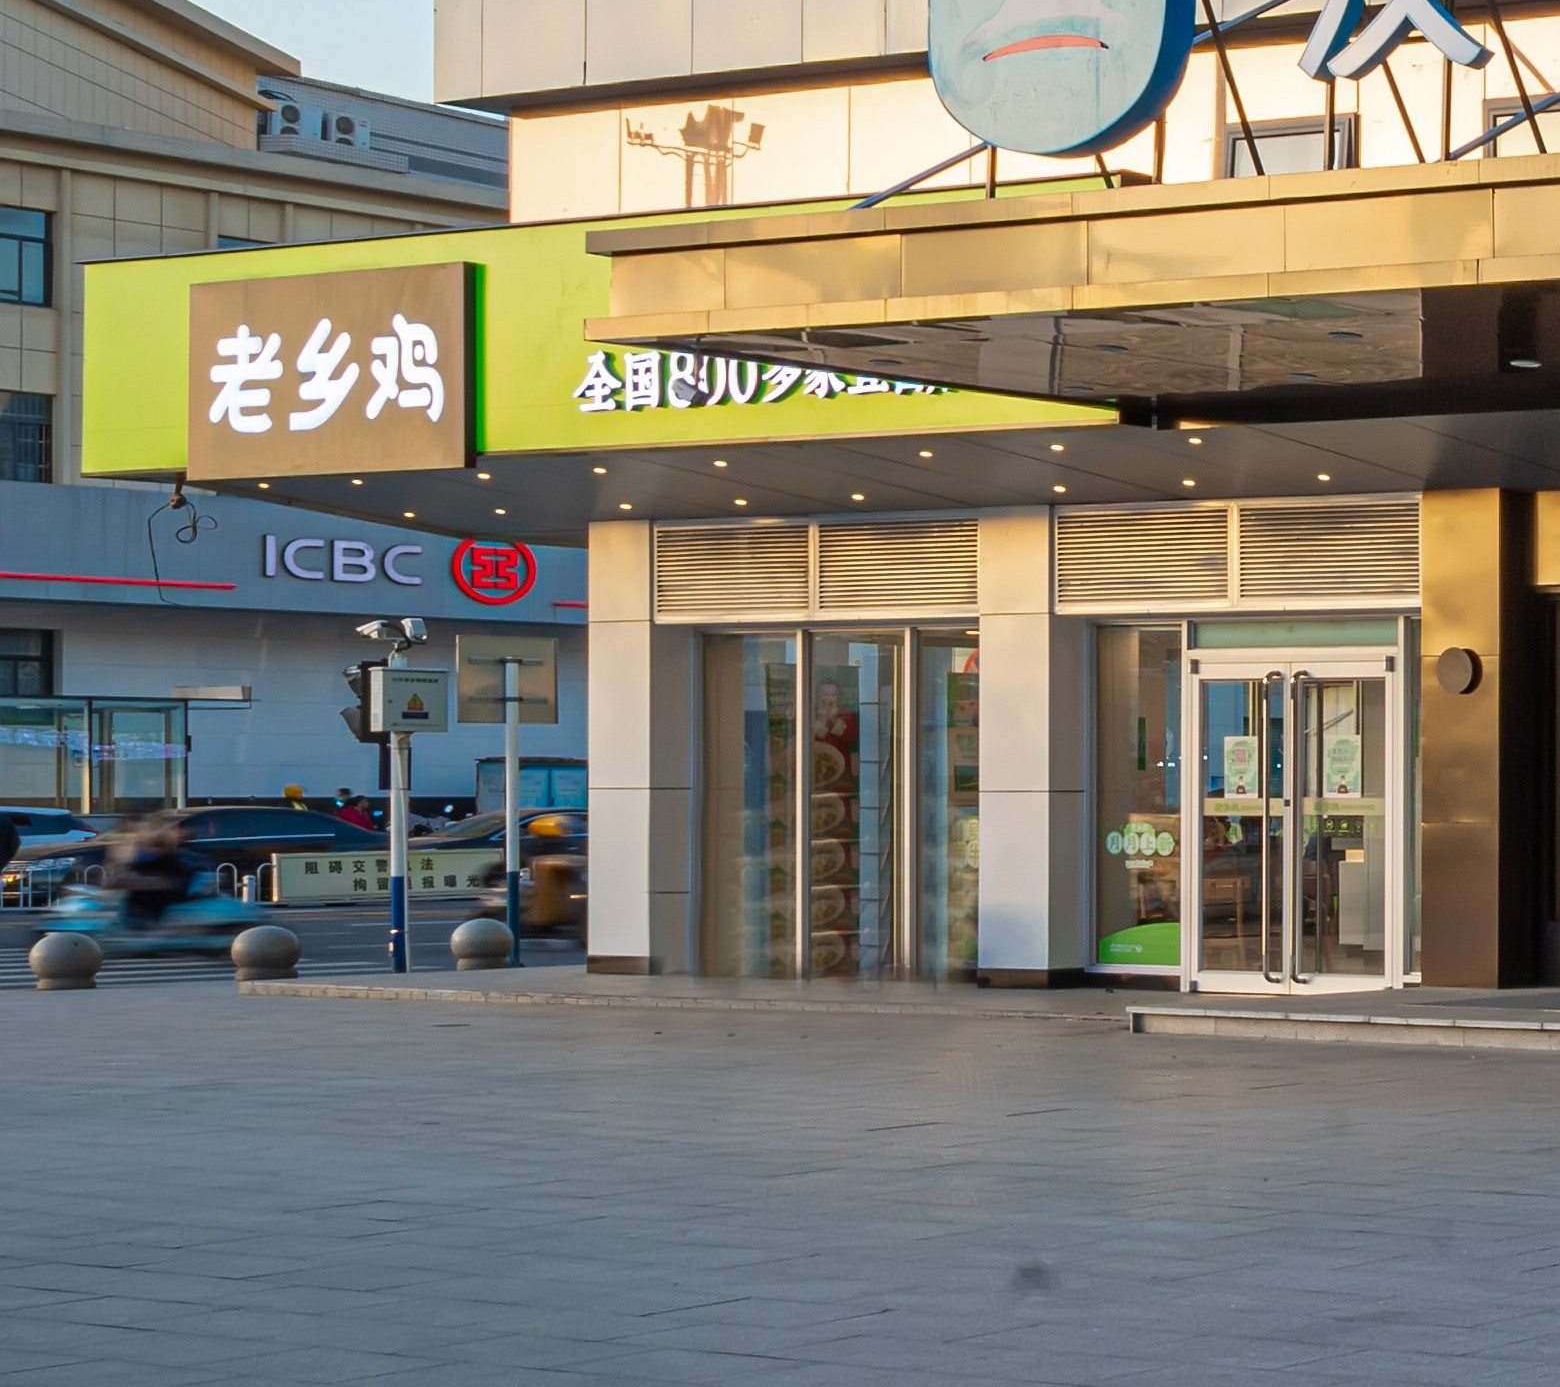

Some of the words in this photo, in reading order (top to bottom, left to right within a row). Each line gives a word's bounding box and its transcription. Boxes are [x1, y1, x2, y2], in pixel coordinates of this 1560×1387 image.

[208, 312, 445, 434] 老乡鸡
[263, 533, 424, 586] ICBC
[304, 857, 434, 875] 阻碍交警法
[352, 874, 480, 892] 拘留报曝光
